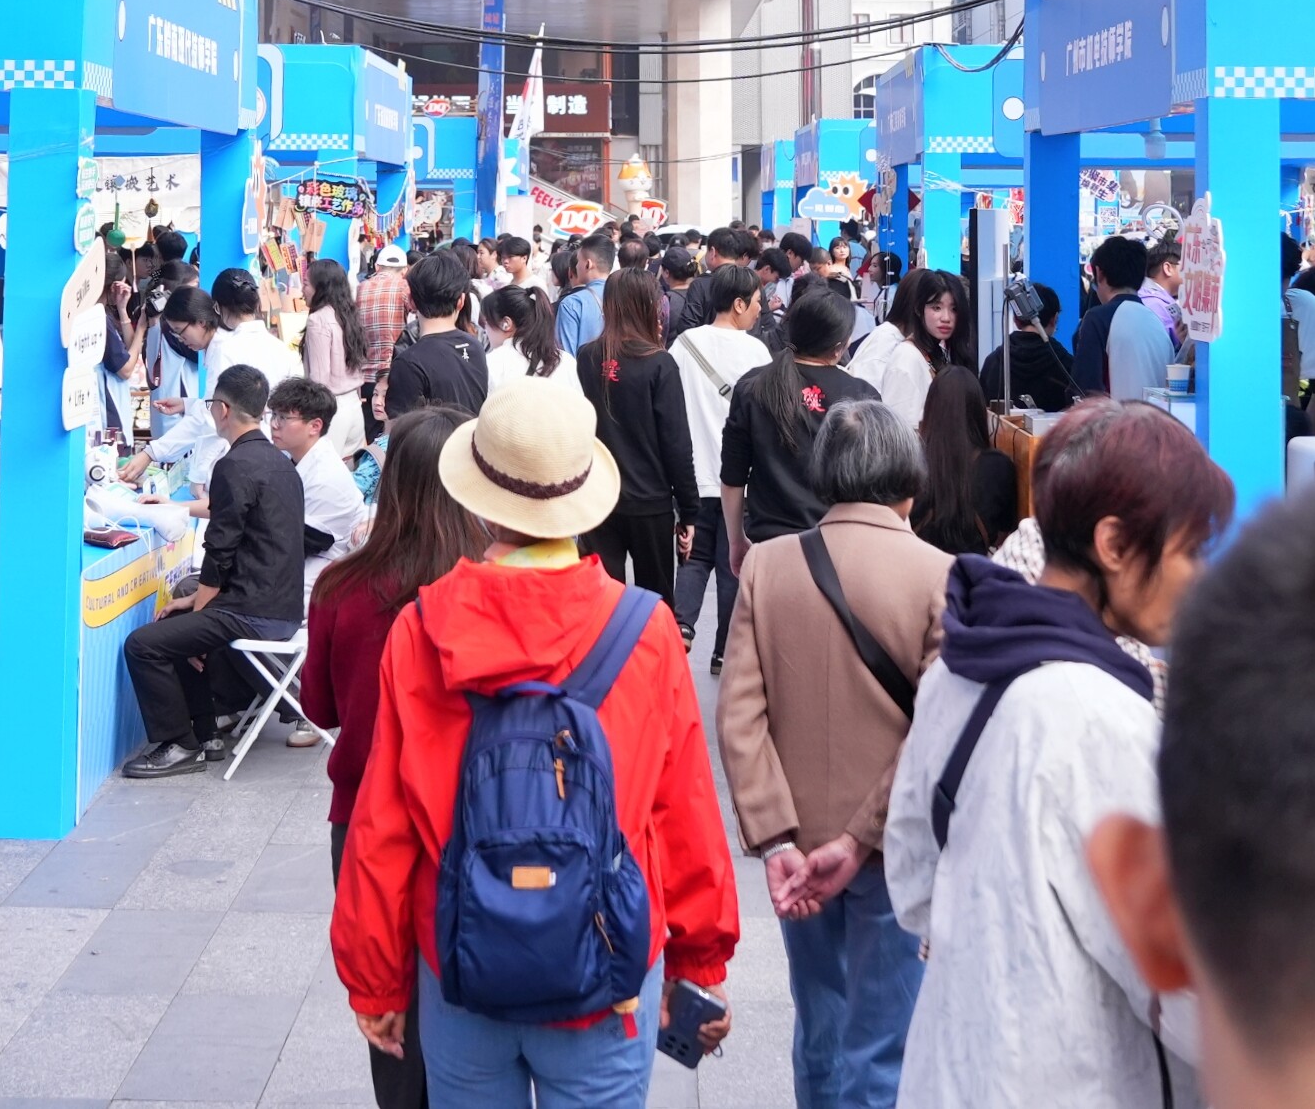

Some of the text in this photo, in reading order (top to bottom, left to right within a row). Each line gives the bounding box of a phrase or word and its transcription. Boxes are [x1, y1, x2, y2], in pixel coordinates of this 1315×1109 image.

[505, 94, 588, 115] 当制造
[561, 209, 597, 231] DQ
[74, 389, 85, 408] Life
[85, 591, 115, 611] CULTURAL
[117, 583, 129, 598] AND
